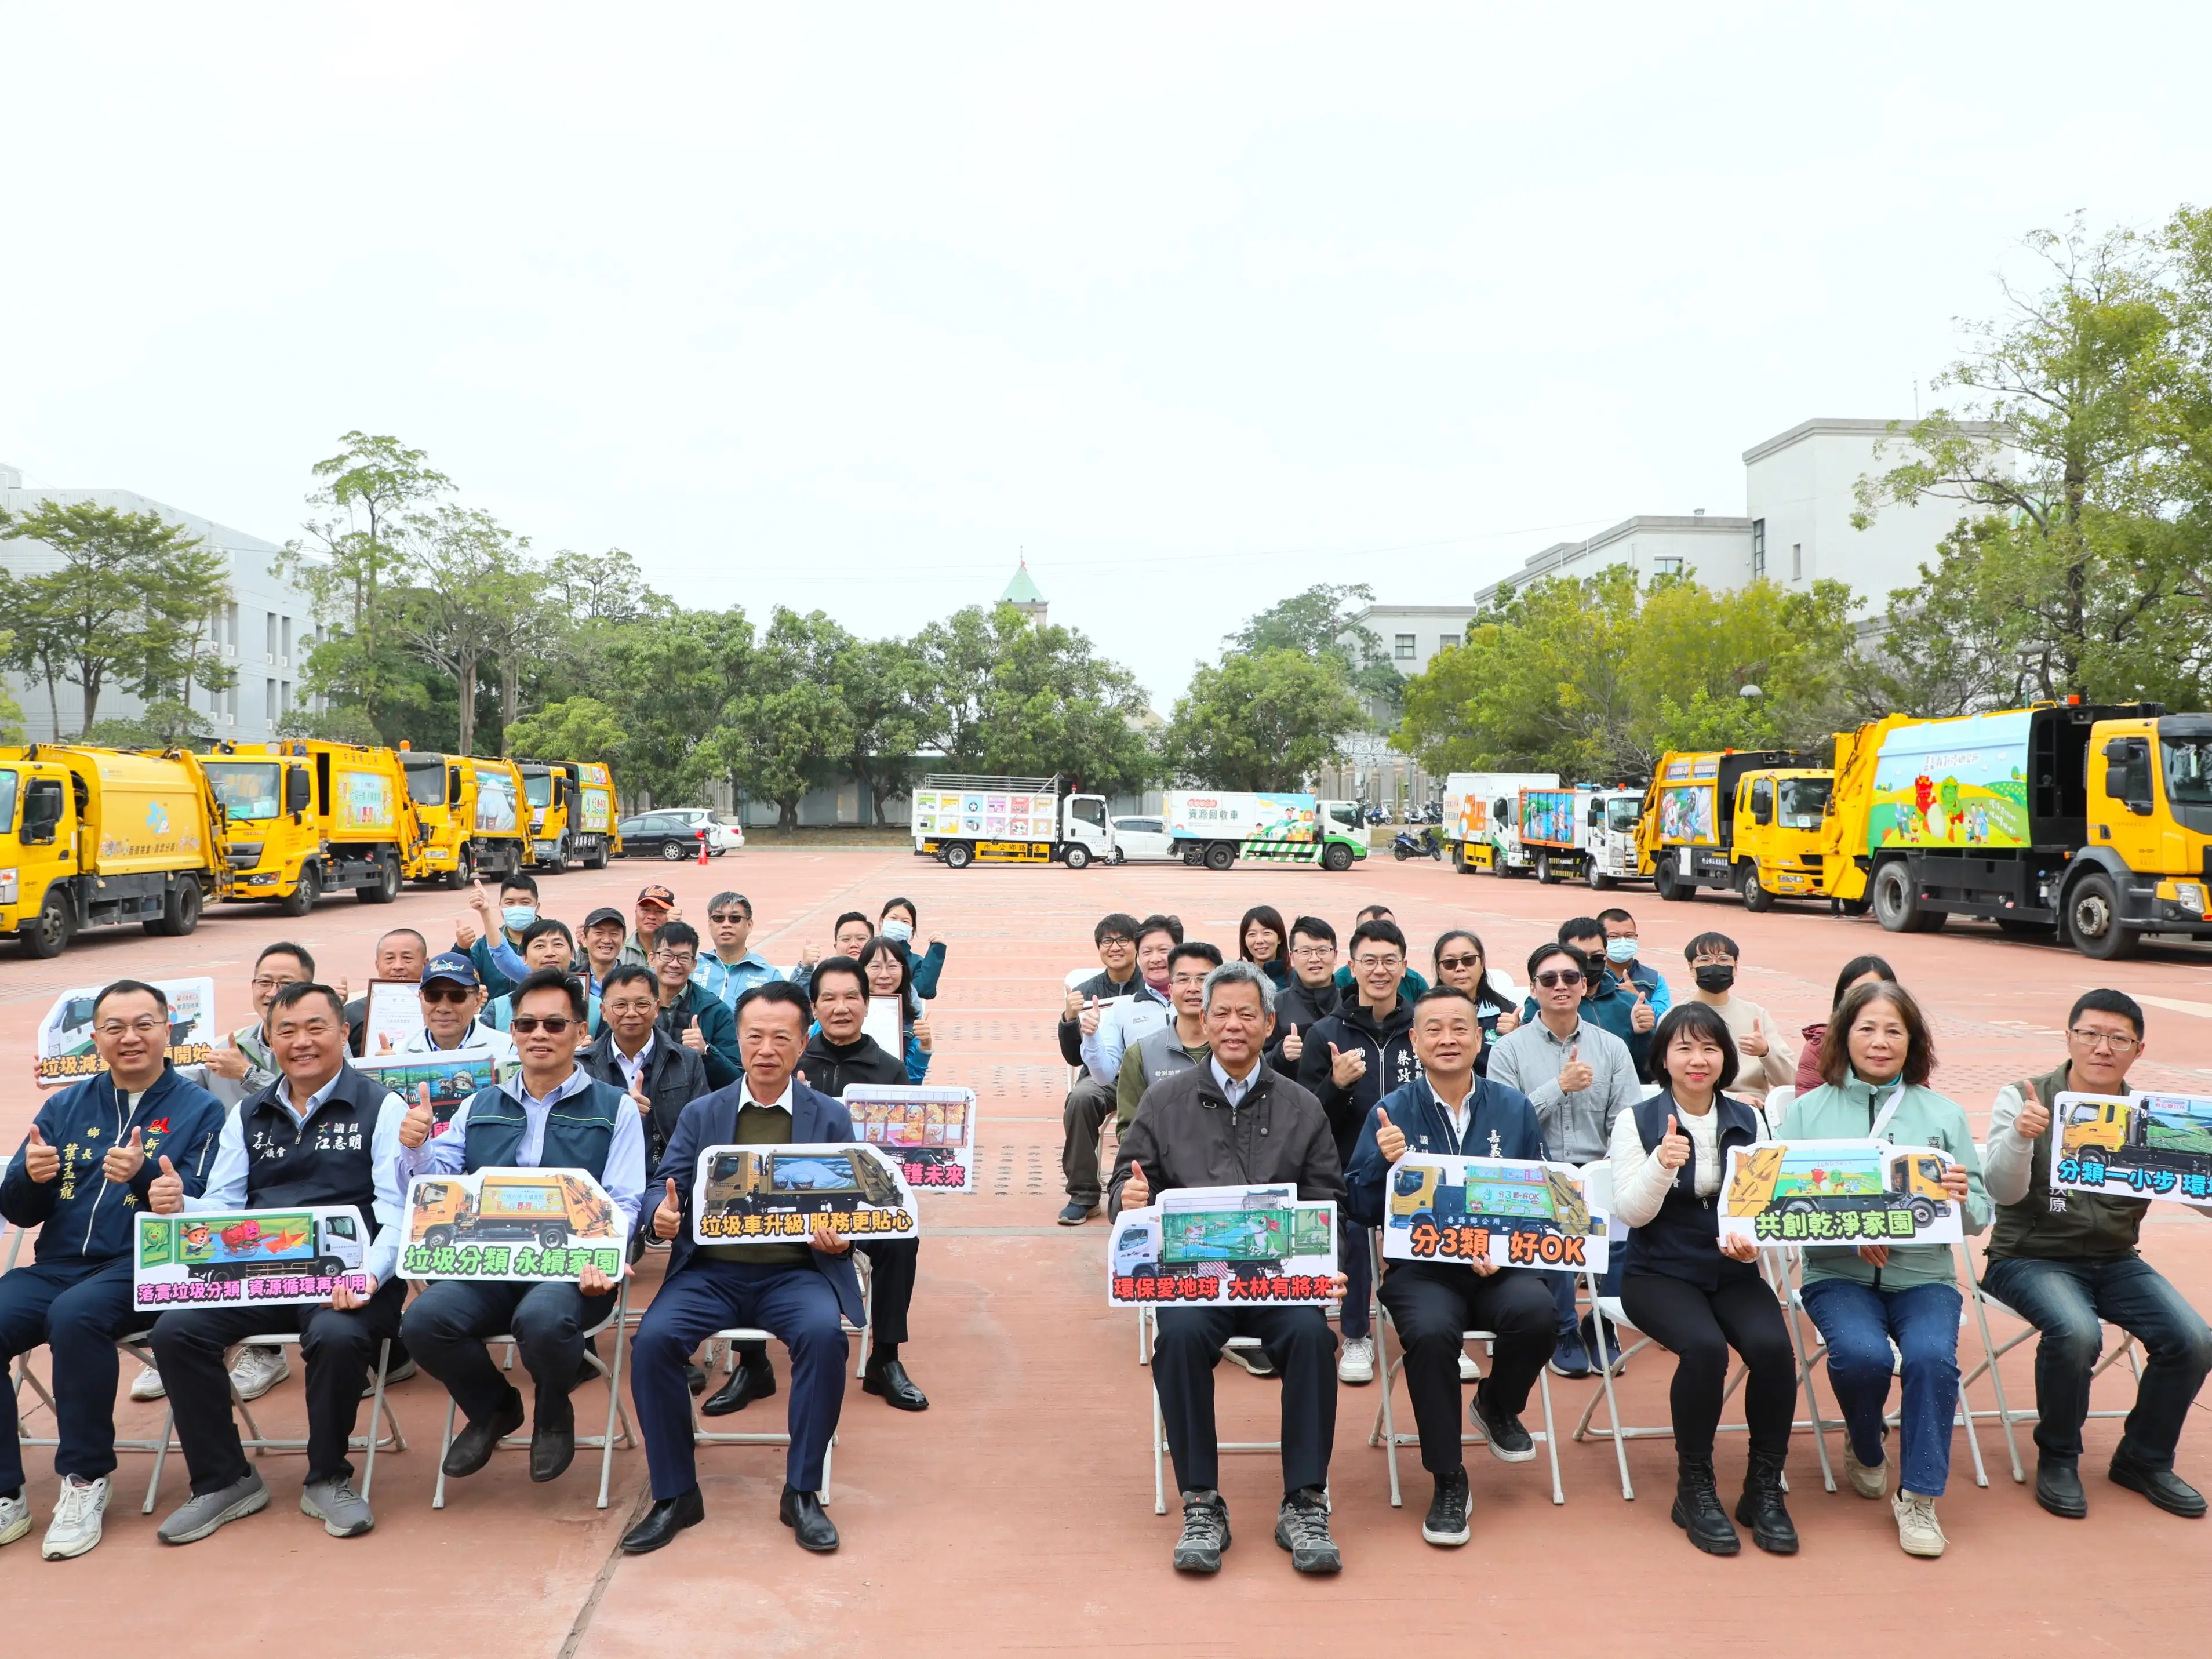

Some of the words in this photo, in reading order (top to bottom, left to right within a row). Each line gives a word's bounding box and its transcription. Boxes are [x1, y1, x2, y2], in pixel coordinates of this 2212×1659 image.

[1188, 809, 1239, 820] 資源回收車
[315, 1134, 362, 1151] 江志明
[333, 1123, 359, 1134] 議員
[1487, 1129, 1503, 1158] 嘉義
[60, 1143, 80, 1199] 葉孟龍
[898, 1162, 965, 1188] 護未來
[2058, 1159, 2177, 1192] 分類一小步
[700, 1213, 805, 1237] 垃圾車升級
[809, 1209, 913, 1235] 服務更貼心
[1447, 1216, 1501, 1226] 番路鄉公所
[1755, 1209, 1915, 1240] 共創乾淨家園
[1410, 1223, 1490, 1258] 分3類
[1509, 1229, 1586, 1264] 好OK
[403, 1245, 511, 1275] 垃圾分類
[514, 1247, 621, 1278] 永續家園
[137, 1280, 241, 1304] 落實垃圾分類
[248, 1274, 366, 1301] 資源循環再利用
[1112, 1275, 1219, 1301] 環保愛地球
[1227, 1274, 1333, 1301] 大林有將來
